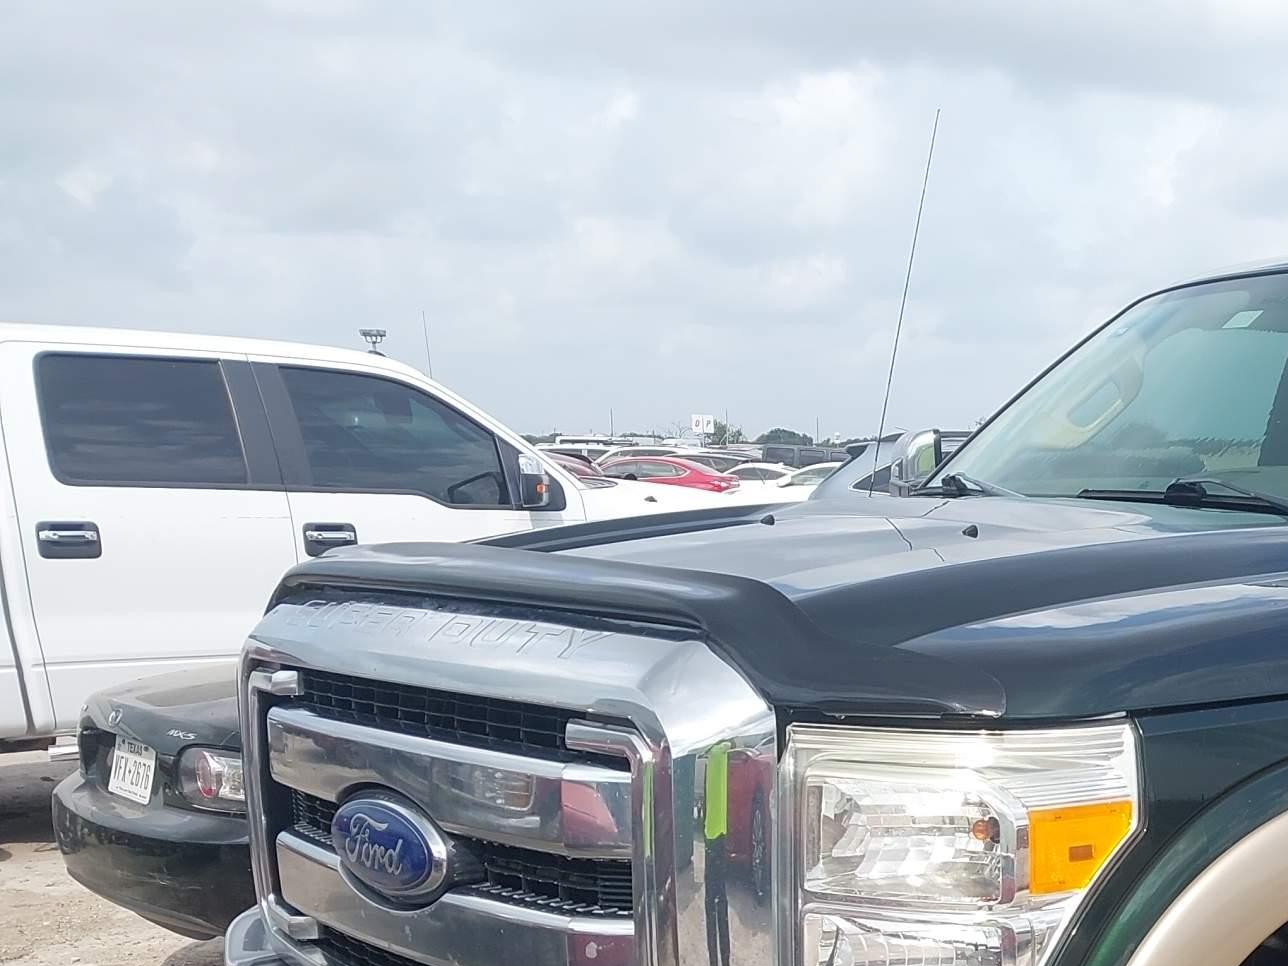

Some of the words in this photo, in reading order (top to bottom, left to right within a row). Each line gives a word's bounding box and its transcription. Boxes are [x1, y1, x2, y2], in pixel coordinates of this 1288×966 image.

[427, 604, 617, 660] DUTY
[127, 741, 143, 757] TEXAS
[345, 812, 404, 876] Ford
